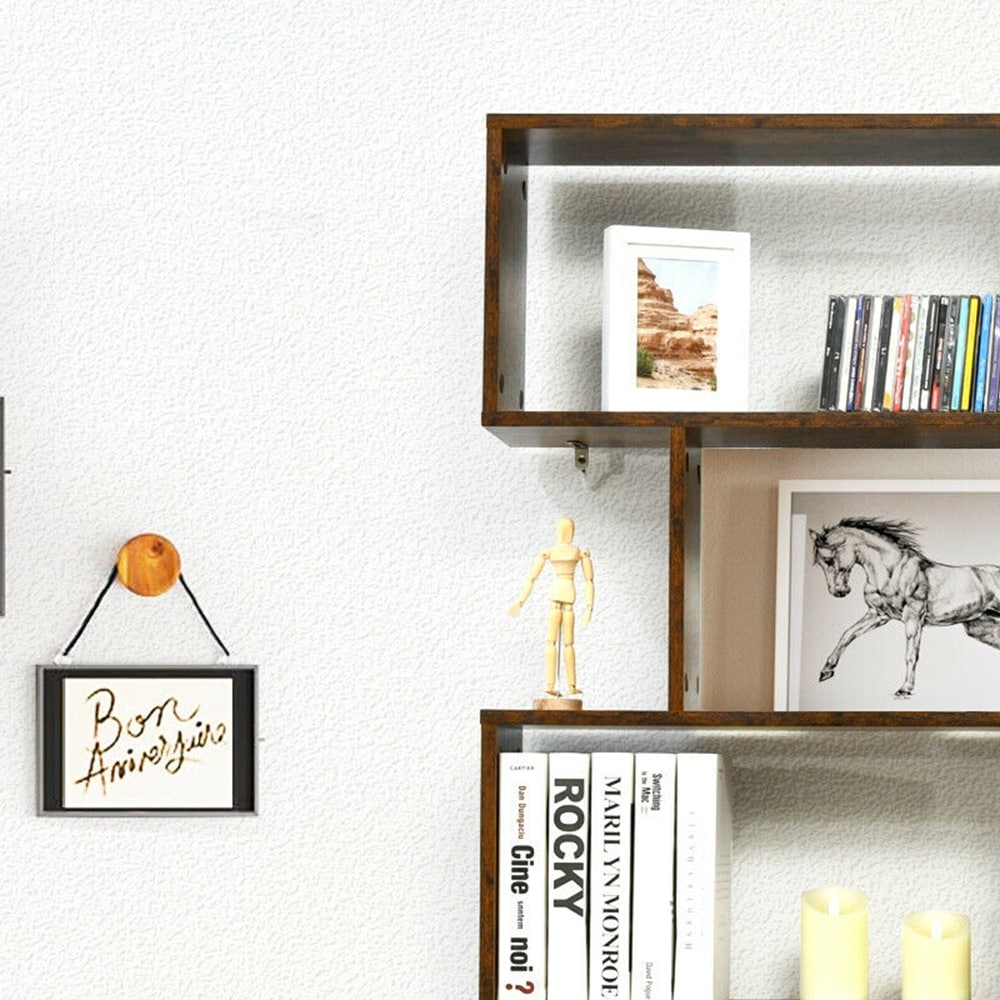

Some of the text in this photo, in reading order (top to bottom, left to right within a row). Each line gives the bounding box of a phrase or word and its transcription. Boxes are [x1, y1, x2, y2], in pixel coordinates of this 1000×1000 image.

[86, 687, 200, 752] Bon
[518, 785, 527, 801] Dan
[641, 786, 650, 803] Mac
[651, 773, 664, 811] Switching
[553, 778, 585, 918] ROCKY
[510, 845, 535, 894] Cine
[601, 776, 622, 998] MARILYN MONROE
[510, 937, 534, 972] noi
[505, 981, 535, 995] ?
